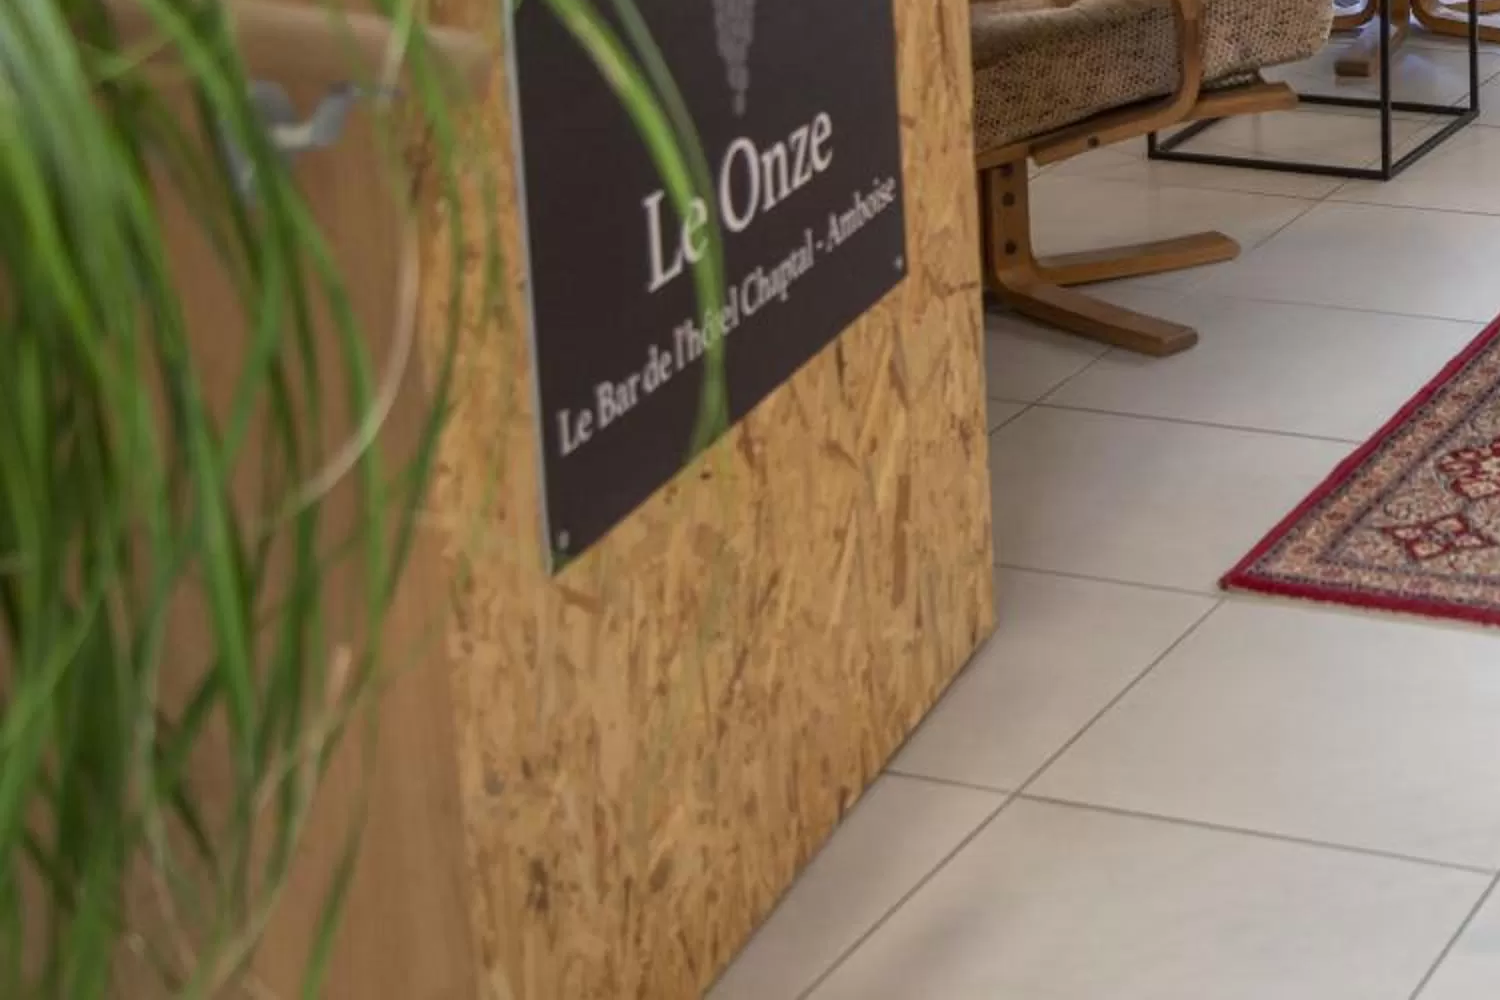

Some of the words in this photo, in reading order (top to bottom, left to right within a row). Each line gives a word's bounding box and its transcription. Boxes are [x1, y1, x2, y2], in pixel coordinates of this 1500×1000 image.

[556, 408, 593, 456] Le
[595, 379, 641, 429] Bar
[643, 344, 673, 394] de
[672, 284, 740, 371] l'hôel
[741, 227, 814, 316] Chaptal
[826, 176, 896, 252] Amboise
[641, 189, 708, 293] Le
[719, 111, 832, 233] Onze
